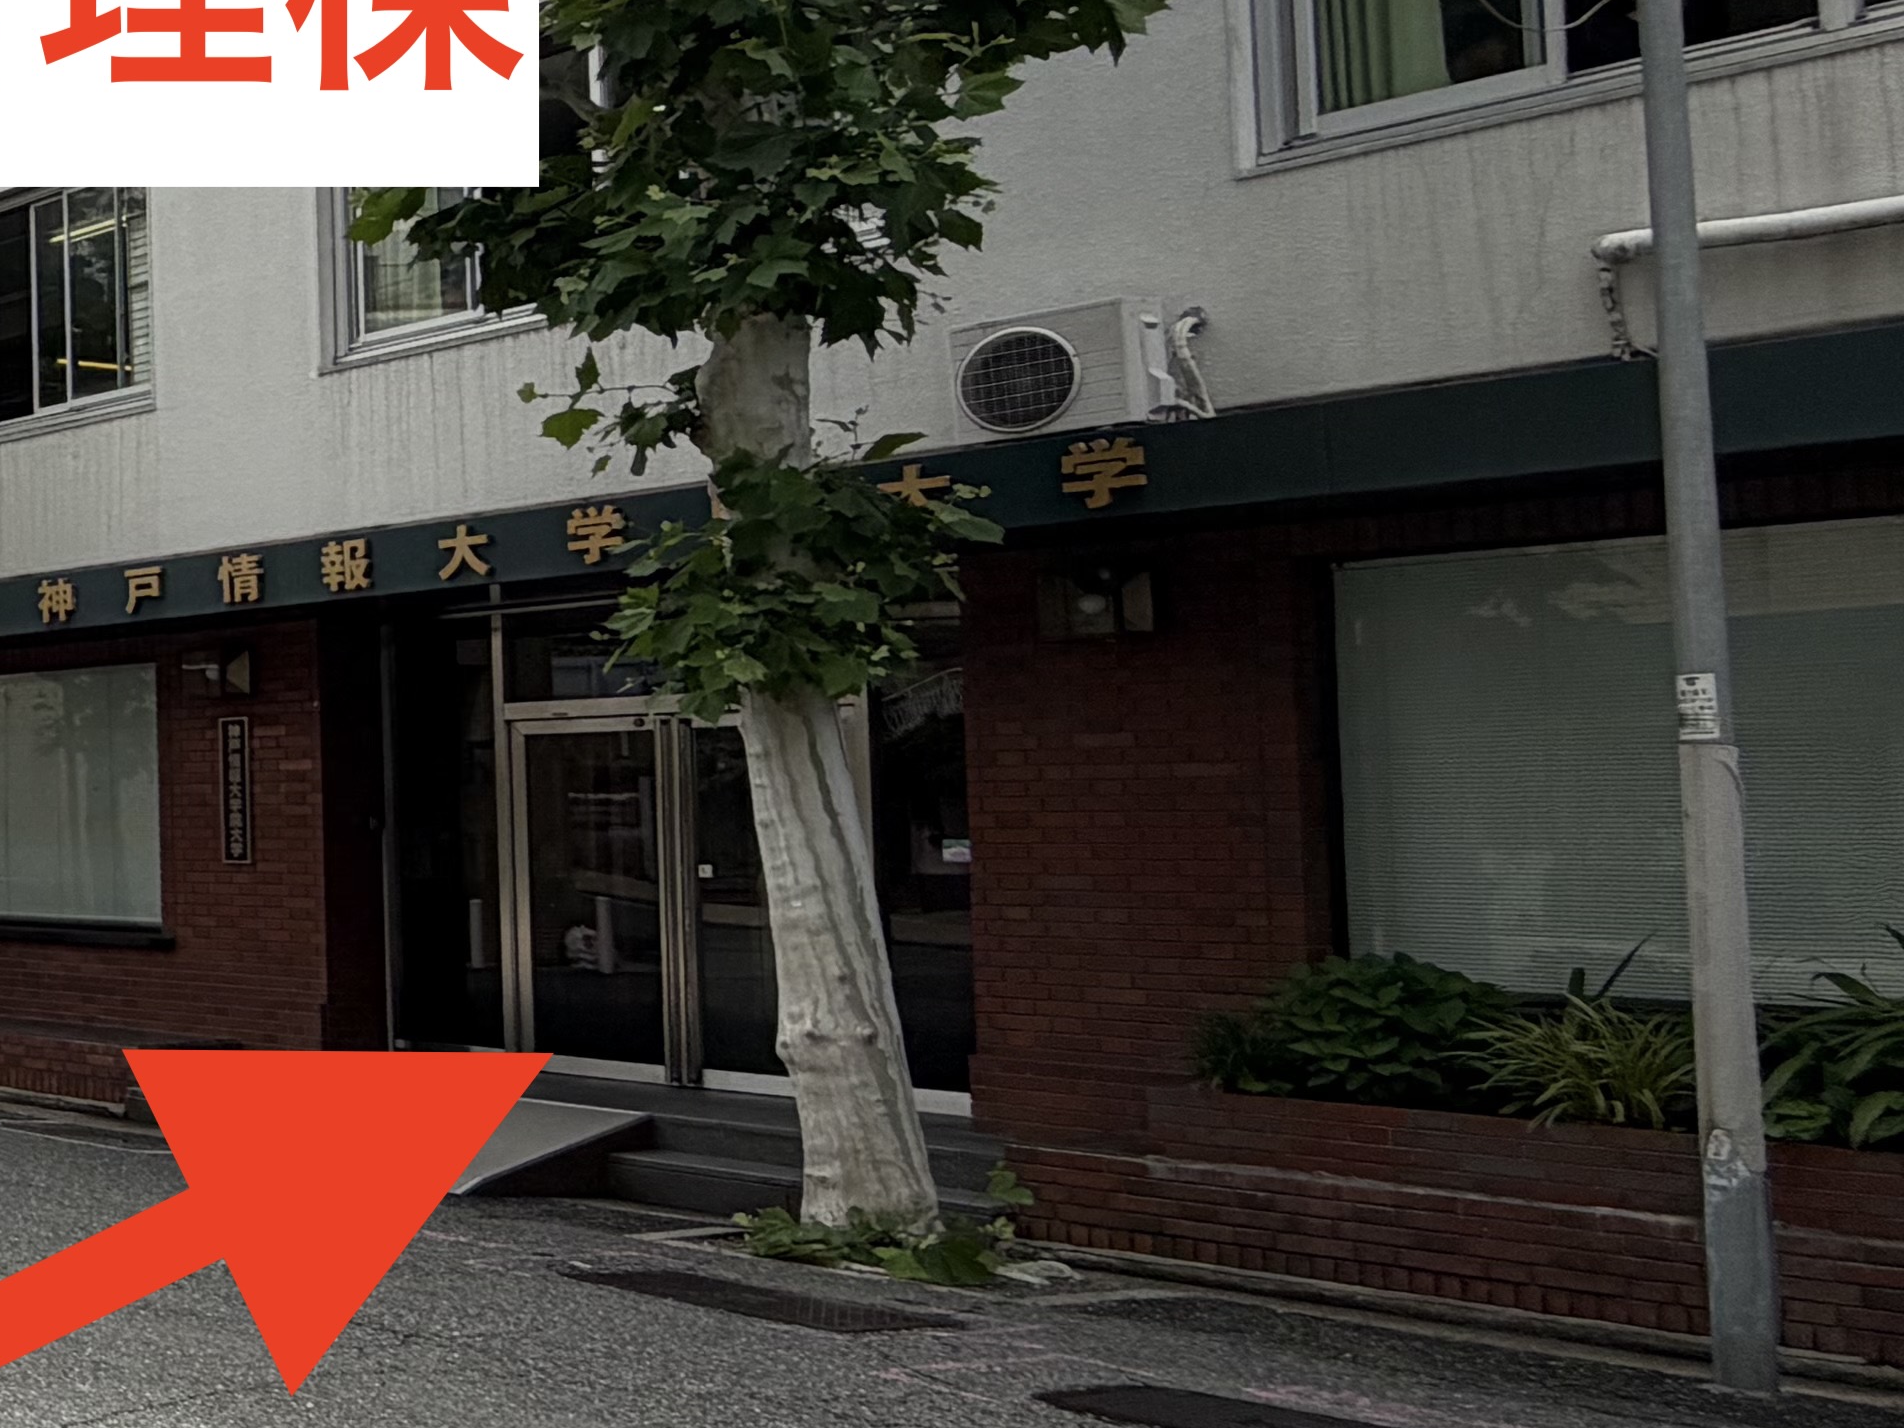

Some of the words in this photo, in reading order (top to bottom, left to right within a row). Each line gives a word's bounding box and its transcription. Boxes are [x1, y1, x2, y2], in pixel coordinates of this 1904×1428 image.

[37, 437, 1148, 624] 神戸情報大学大学
